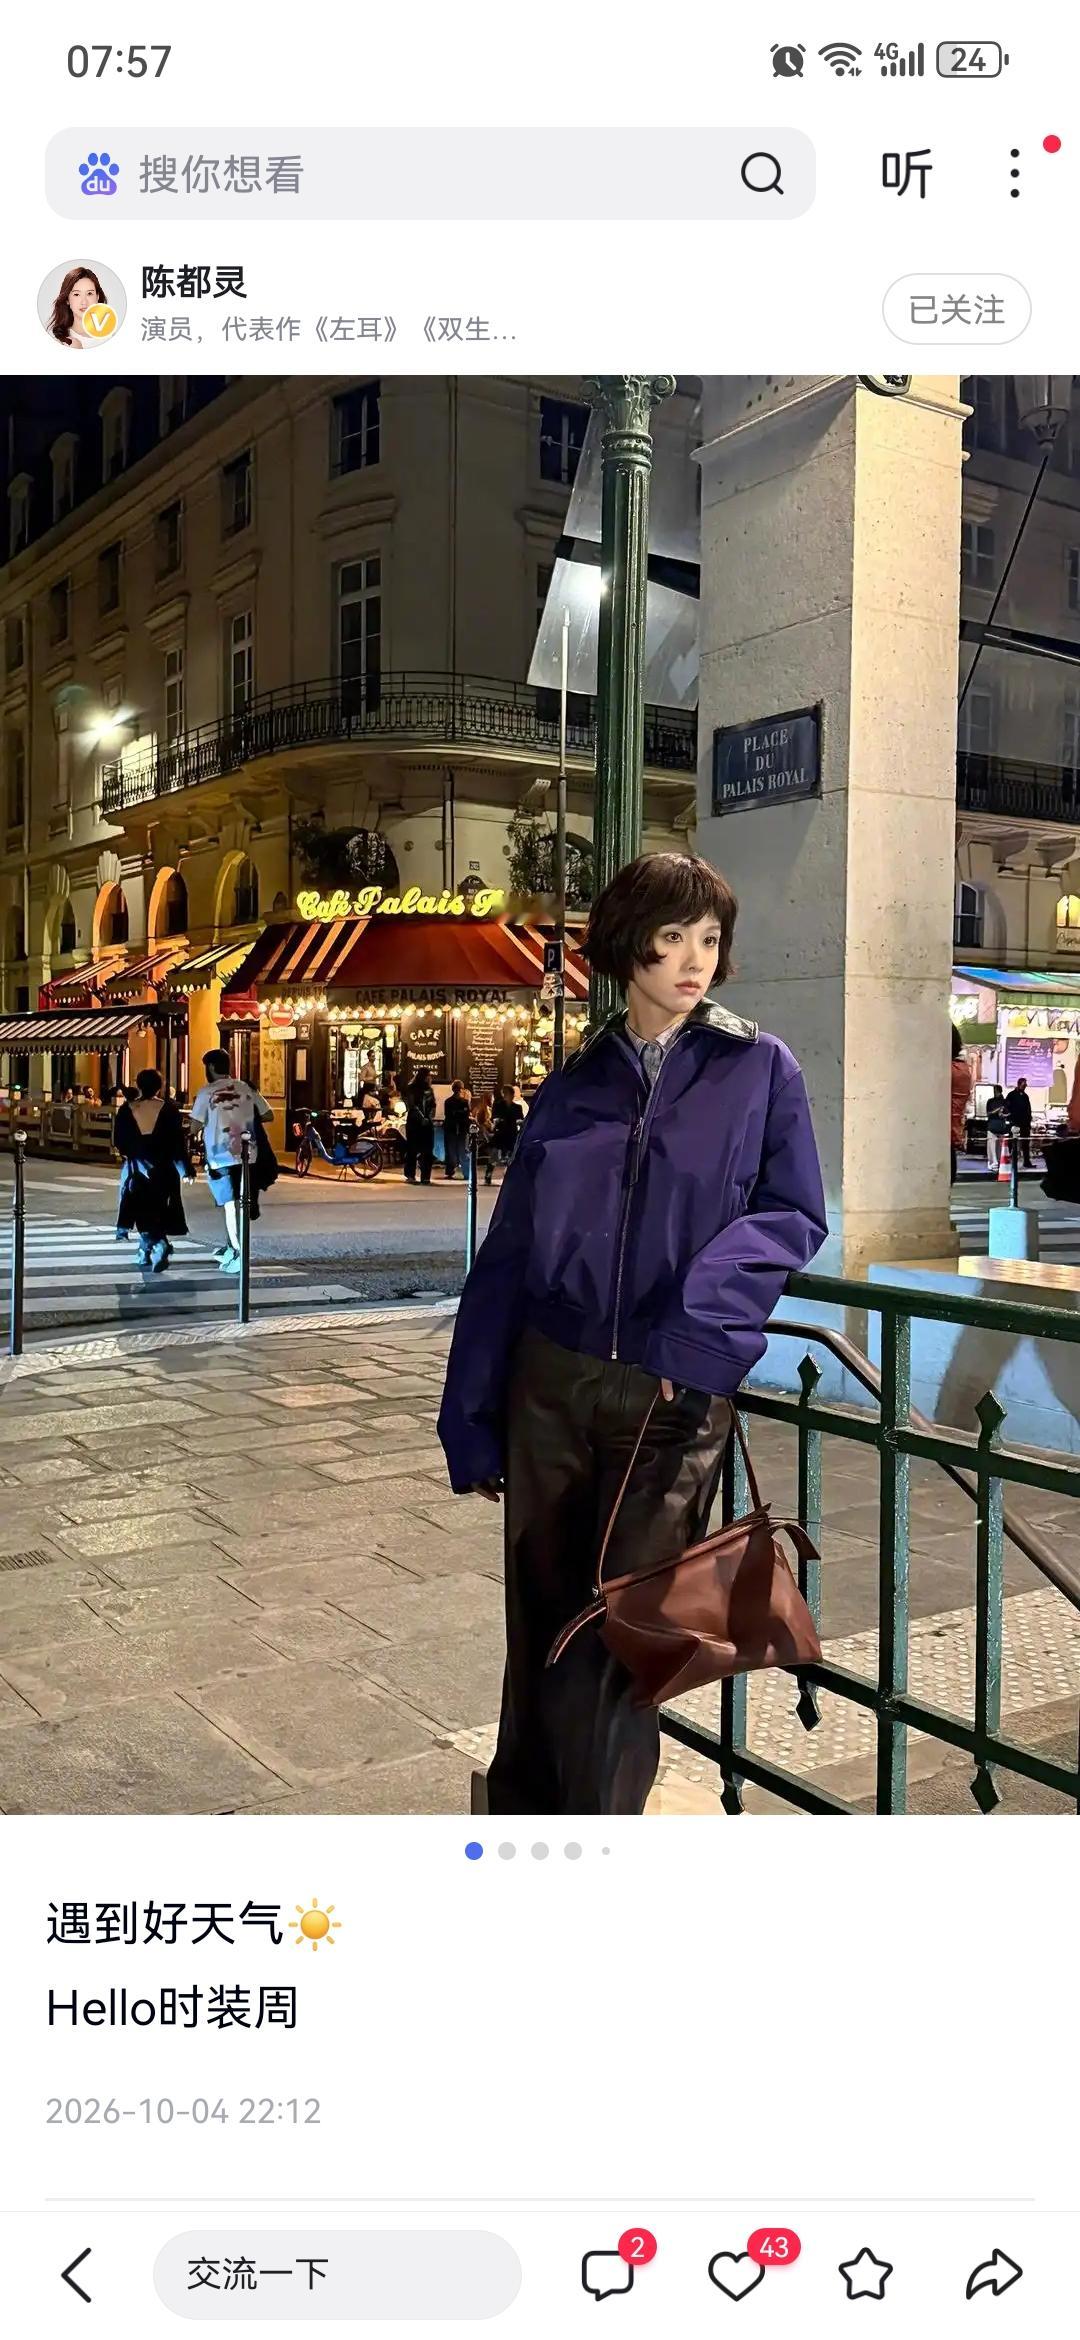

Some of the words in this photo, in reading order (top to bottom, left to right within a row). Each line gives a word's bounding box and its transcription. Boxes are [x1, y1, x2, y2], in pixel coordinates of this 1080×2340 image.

[67, 44, 172, 79] 07:57
[873, 42, 899, 61] 4G
[950, 45, 987, 73] 24
[86, 175, 111, 192] du
[139, 154, 304, 194] 搜你想看
[881, 148, 934, 200] 听
[142, 263, 248, 299] 陈都灵
[909, 294, 1005, 325] 已关注
[743, 729, 788, 753] PLACE
[755, 753, 775, 771] DU
[722, 776, 765, 799] PALAIS
[768, 768, 809, 790] ROYAL
[297, 889, 351, 923] Café
[354, 886, 466, 915] Palais
[547, 949, 555, 968] P
[391, 989, 447, 1002] PALAIS
[455, 989, 512, 1003] ROYAL
[46, 1899, 284, 1946] 遇到好天气
[48, 1983, 297, 2030] Hello时装周
[46, 2098, 229, 2124] 2026-10-04
[239, 2098, 321, 2124] 22:12
[630, 2236, 645, 2259] 2
[759, 2236, 789, 2259] 43
[187, 2255, 329, 2291] 交流一下
